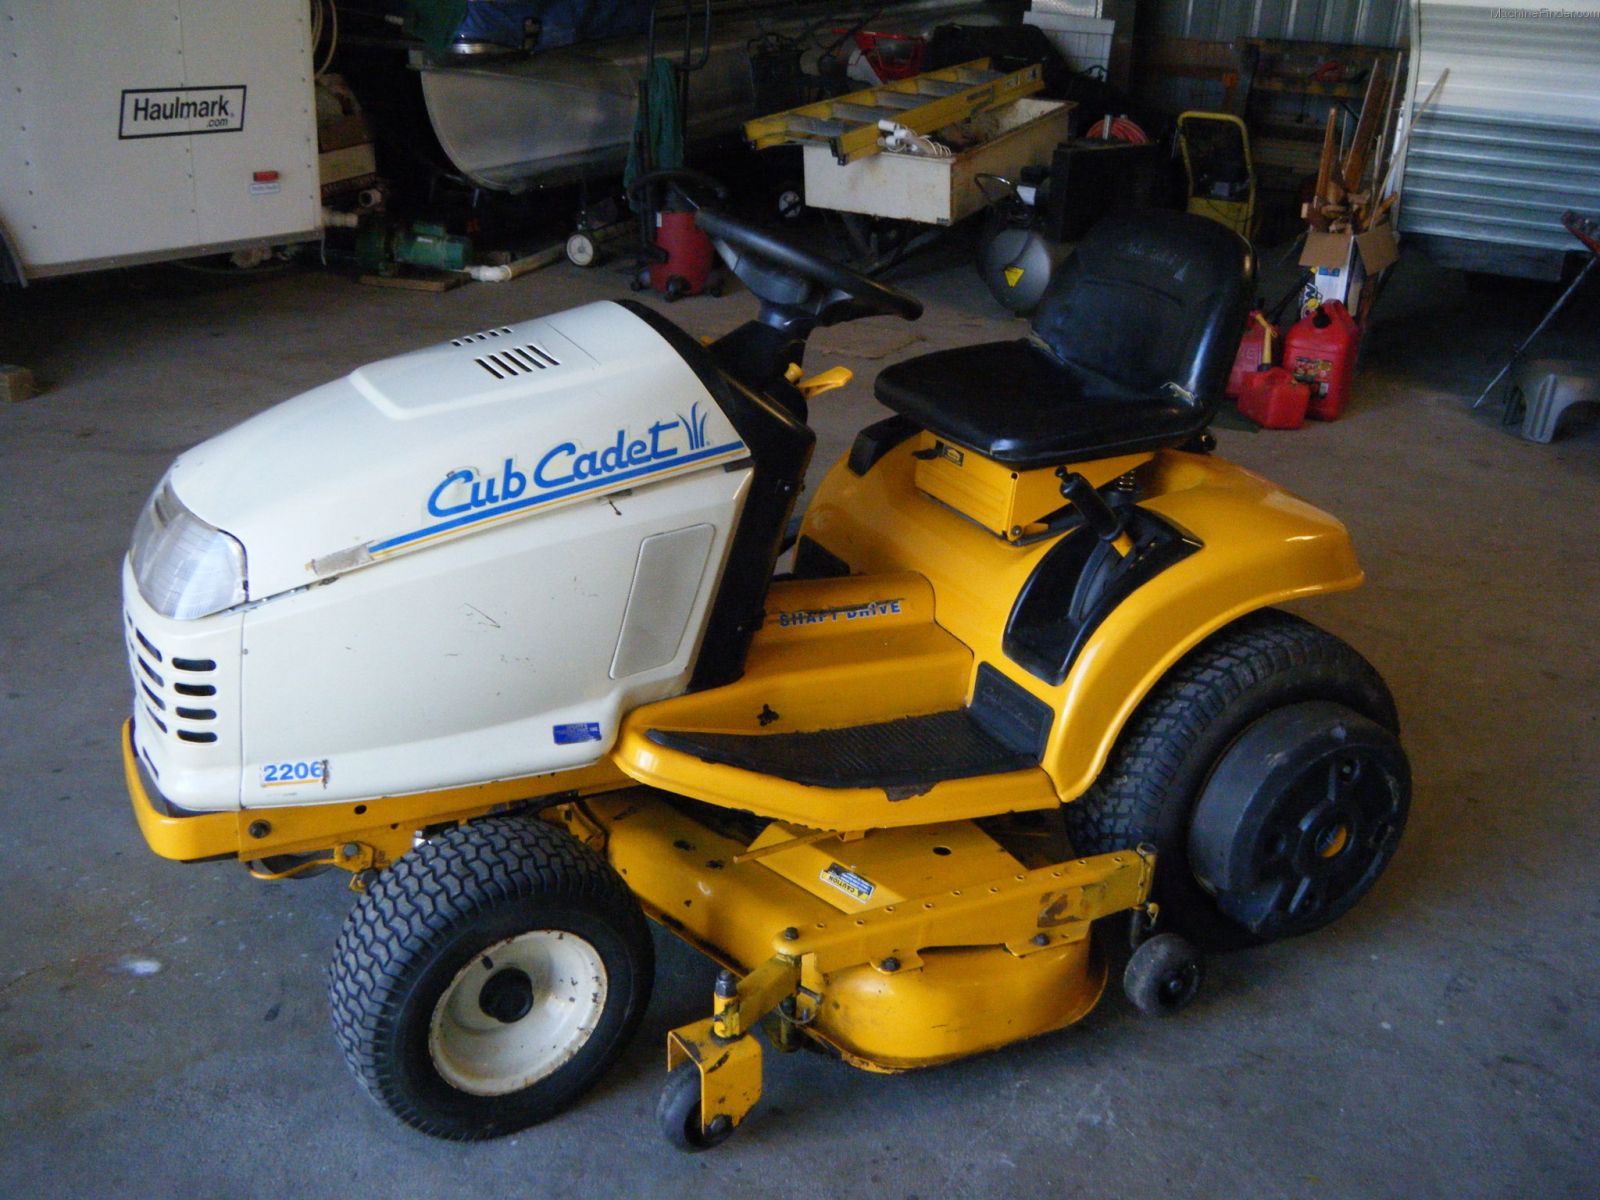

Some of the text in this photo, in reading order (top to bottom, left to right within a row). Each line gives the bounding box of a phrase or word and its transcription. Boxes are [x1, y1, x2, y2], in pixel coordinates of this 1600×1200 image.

[133, 95, 230, 121] Haulmark
[206, 117, 228, 128] .com
[427, 420, 680, 518] Cub Cadet
